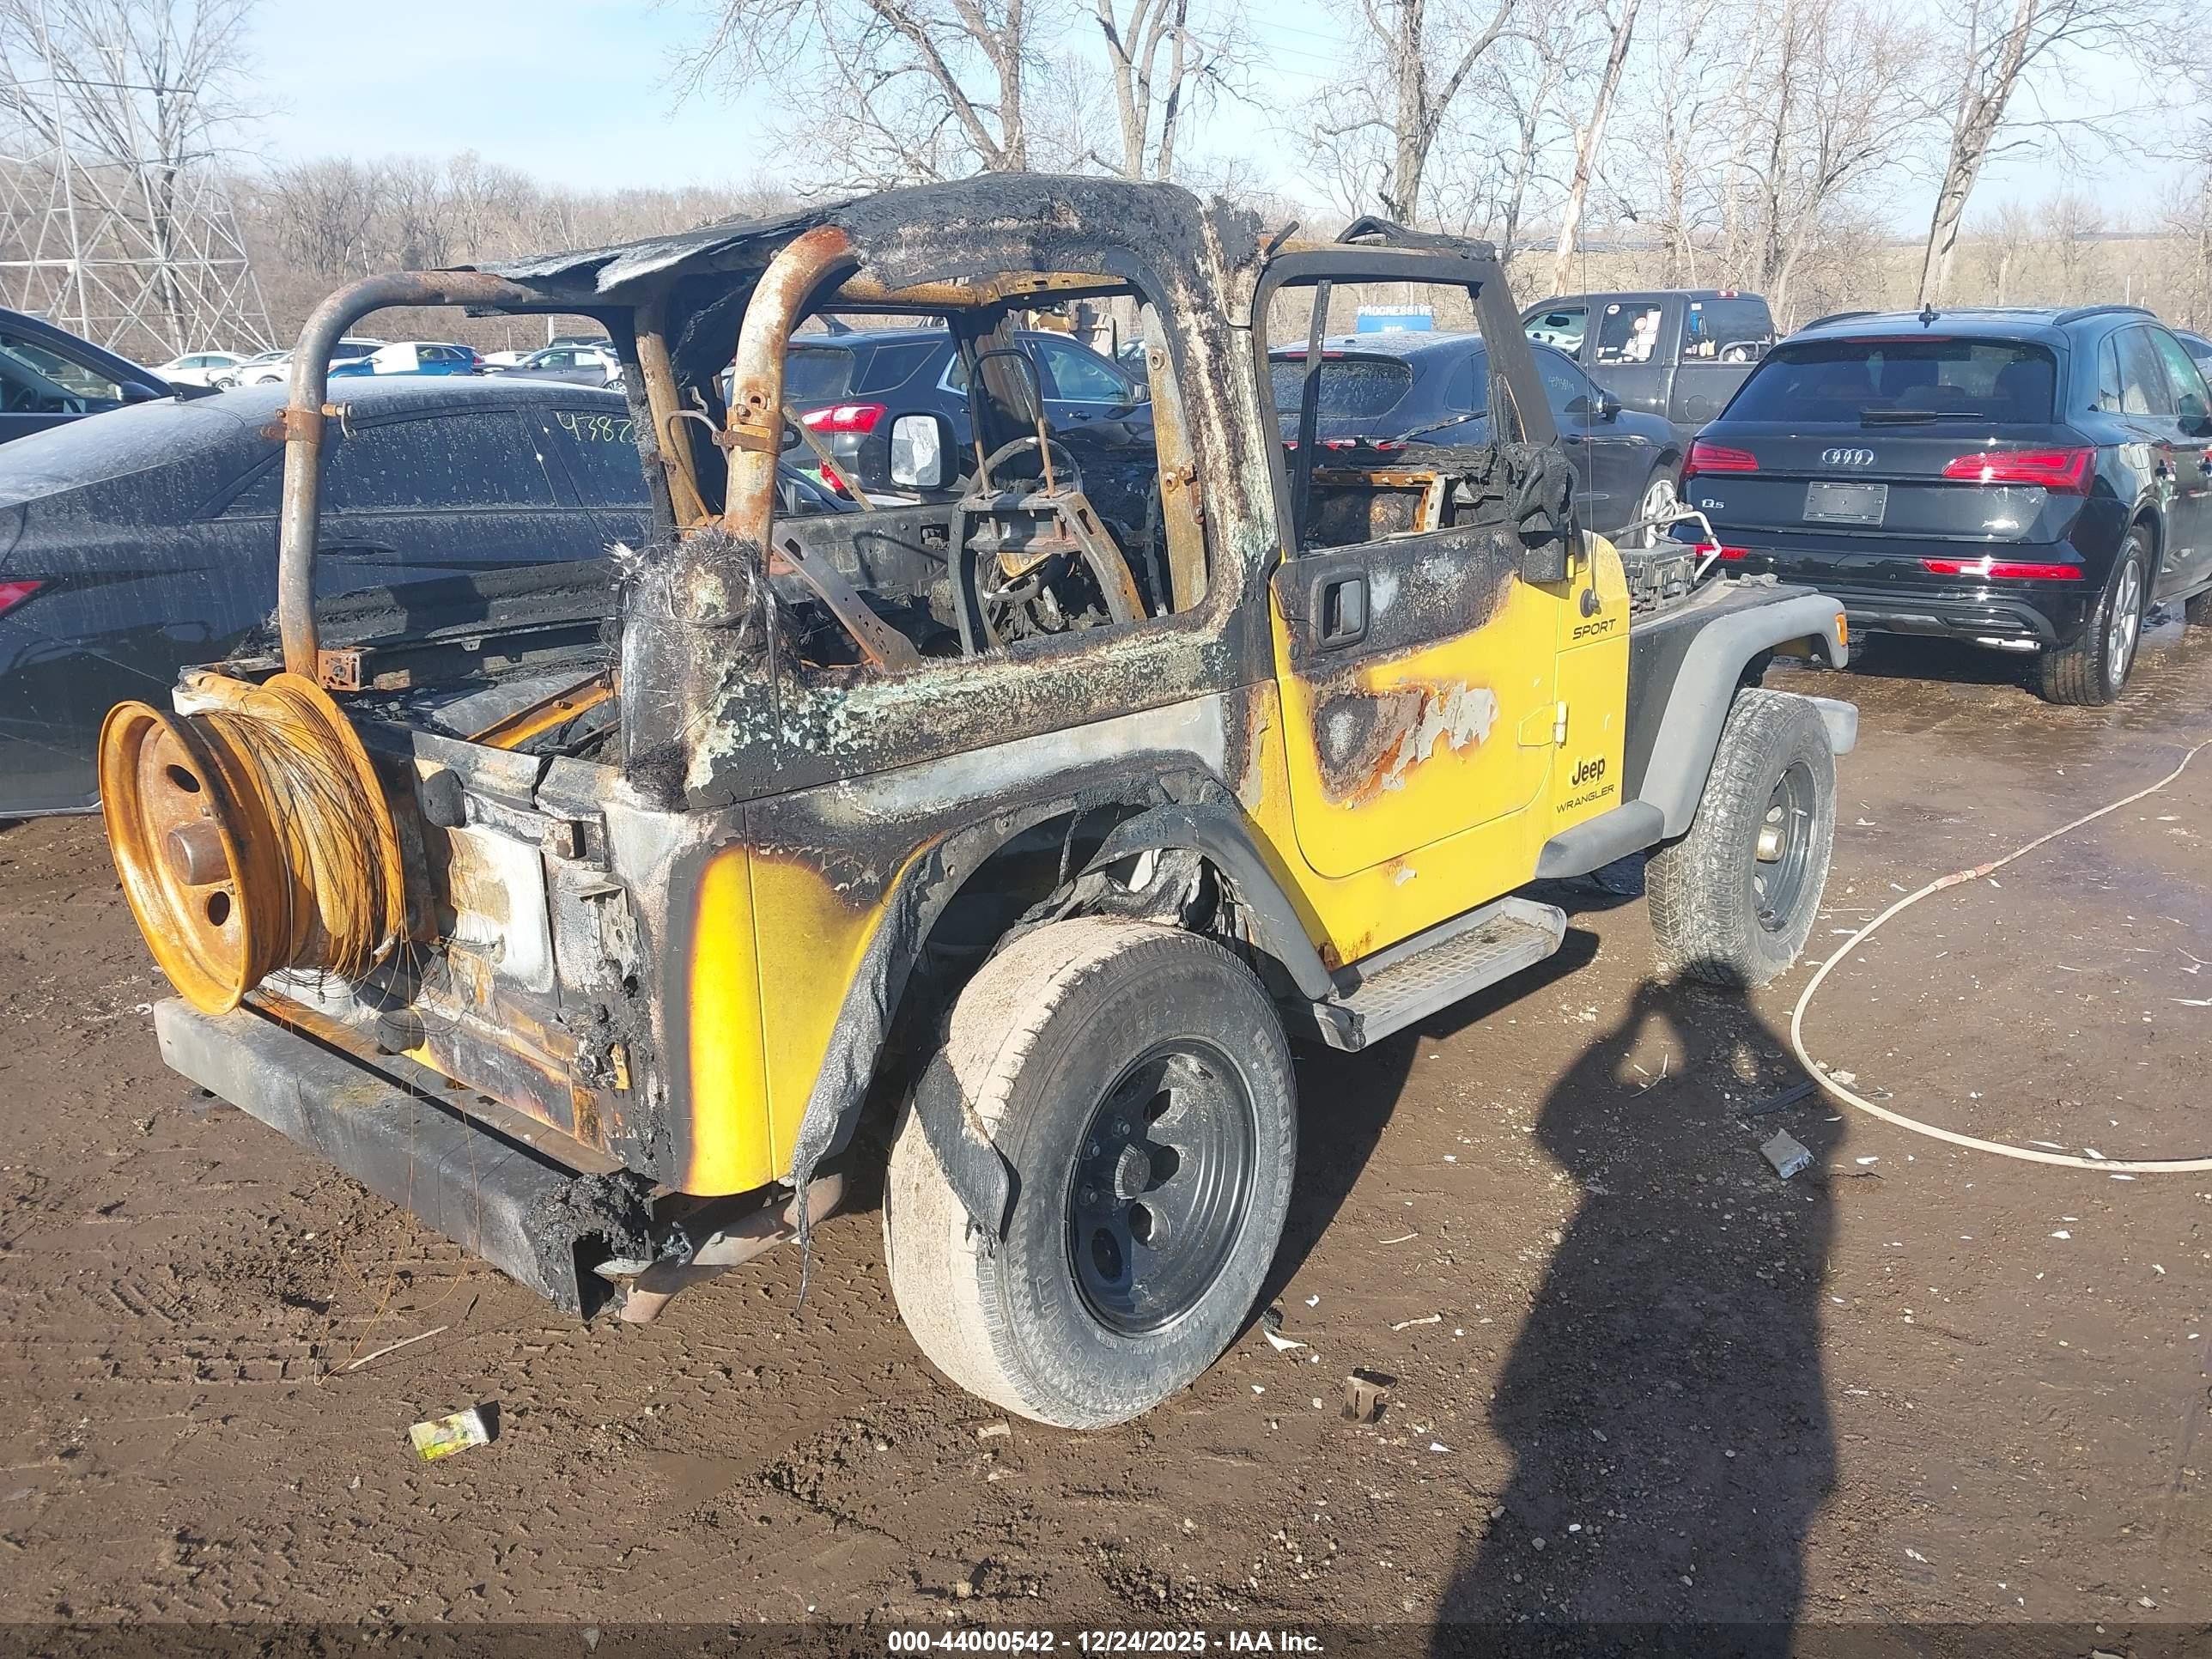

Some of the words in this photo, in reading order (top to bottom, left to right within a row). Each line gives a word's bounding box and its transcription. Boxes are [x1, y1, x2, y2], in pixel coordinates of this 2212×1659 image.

[1358, 305, 1432, 316] PROGRESSIVE
[1572, 618, 1616, 640] SPORT
[1572, 758, 1606, 786] Jeep
[1556, 784, 1614, 814] WRANGLER
